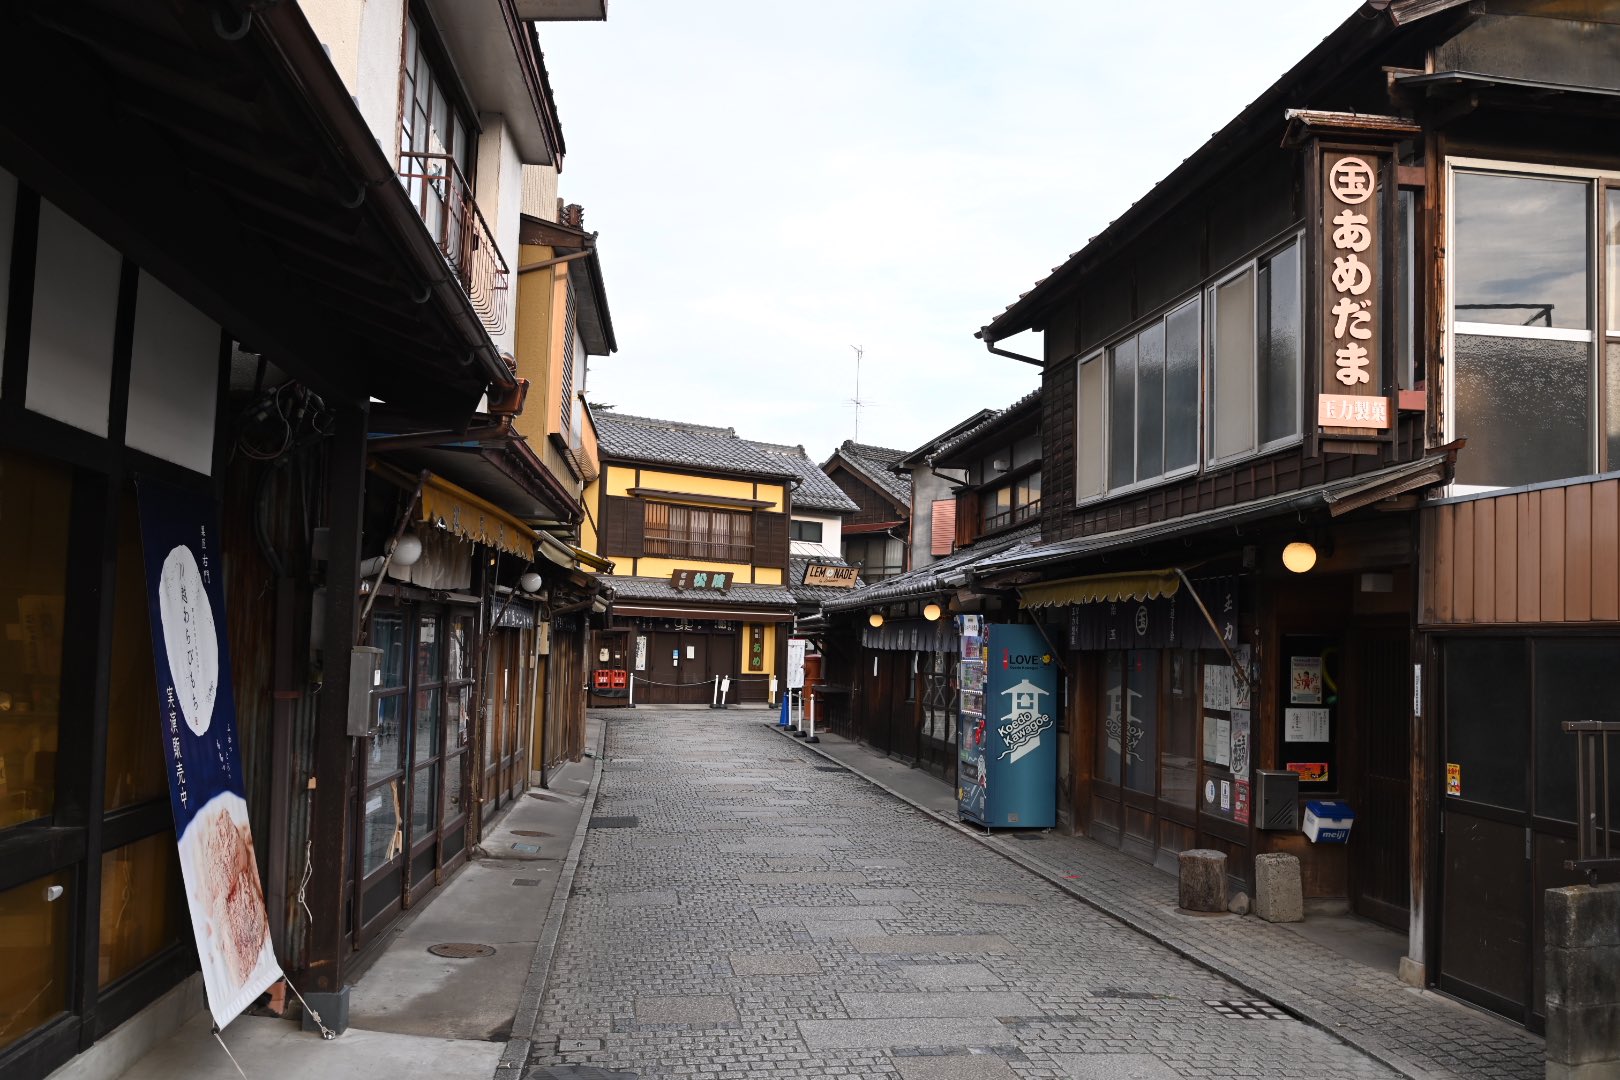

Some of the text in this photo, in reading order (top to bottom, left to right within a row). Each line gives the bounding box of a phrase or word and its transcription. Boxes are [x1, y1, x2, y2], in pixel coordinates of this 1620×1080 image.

[1331, 209, 1372, 386] あめだま
[1321, 399, 1385, 423] 玉力製菓
[753, 643, 760, 666] あめ
[1009, 655, 1038, 664] LOVE
[997, 712, 1031, 737] Koedo
[1003, 714, 1049, 746] Kawagoe
[1322, 830, 1346, 839] meiji
